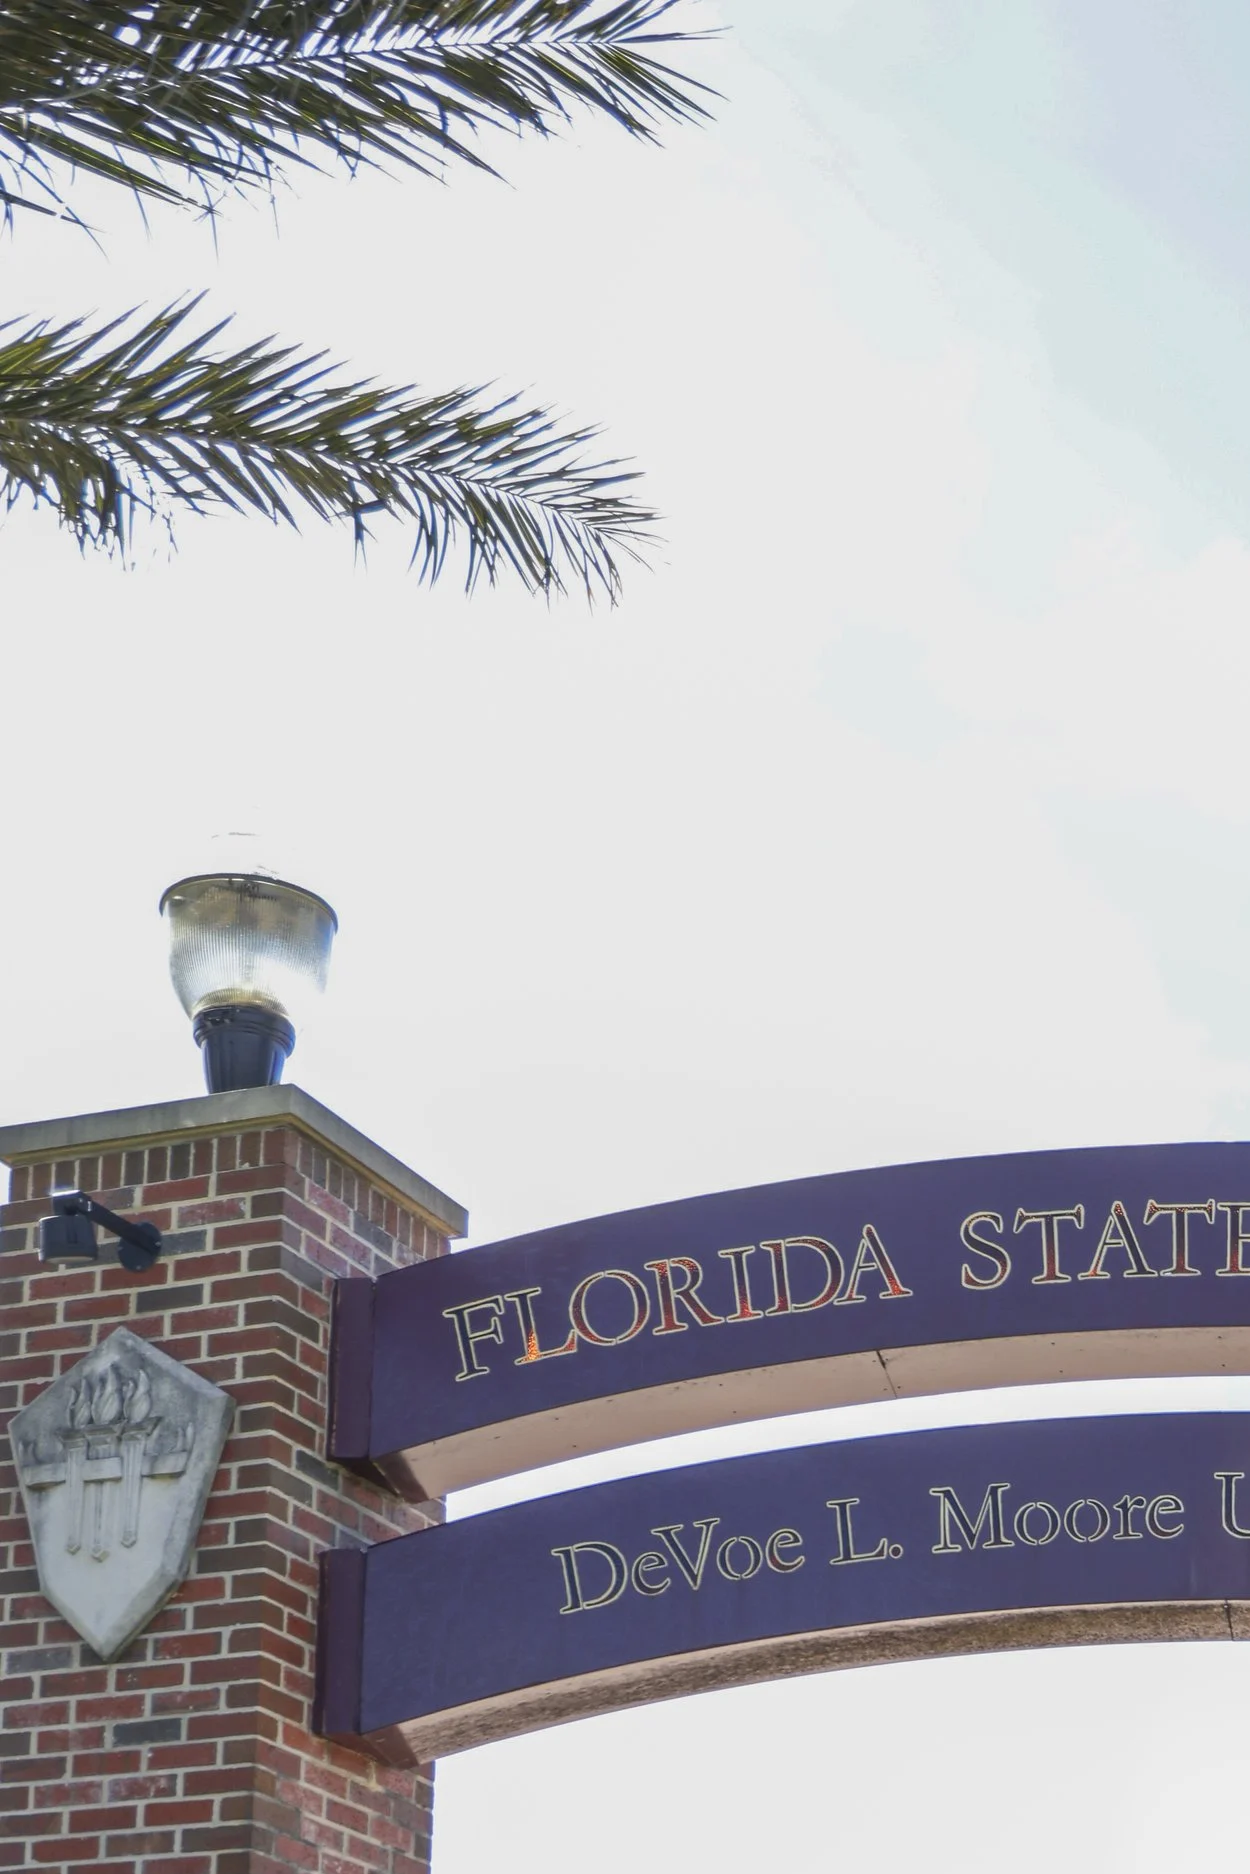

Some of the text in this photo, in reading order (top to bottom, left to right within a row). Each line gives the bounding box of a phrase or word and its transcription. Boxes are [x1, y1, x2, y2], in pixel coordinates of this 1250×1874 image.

[443, 1224, 914, 1382] FLORIDA
[551, 1517, 805, 1615] DeVoe
[827, 1498, 904, 1567] L.
[929, 1483, 1185, 1555] Moore
